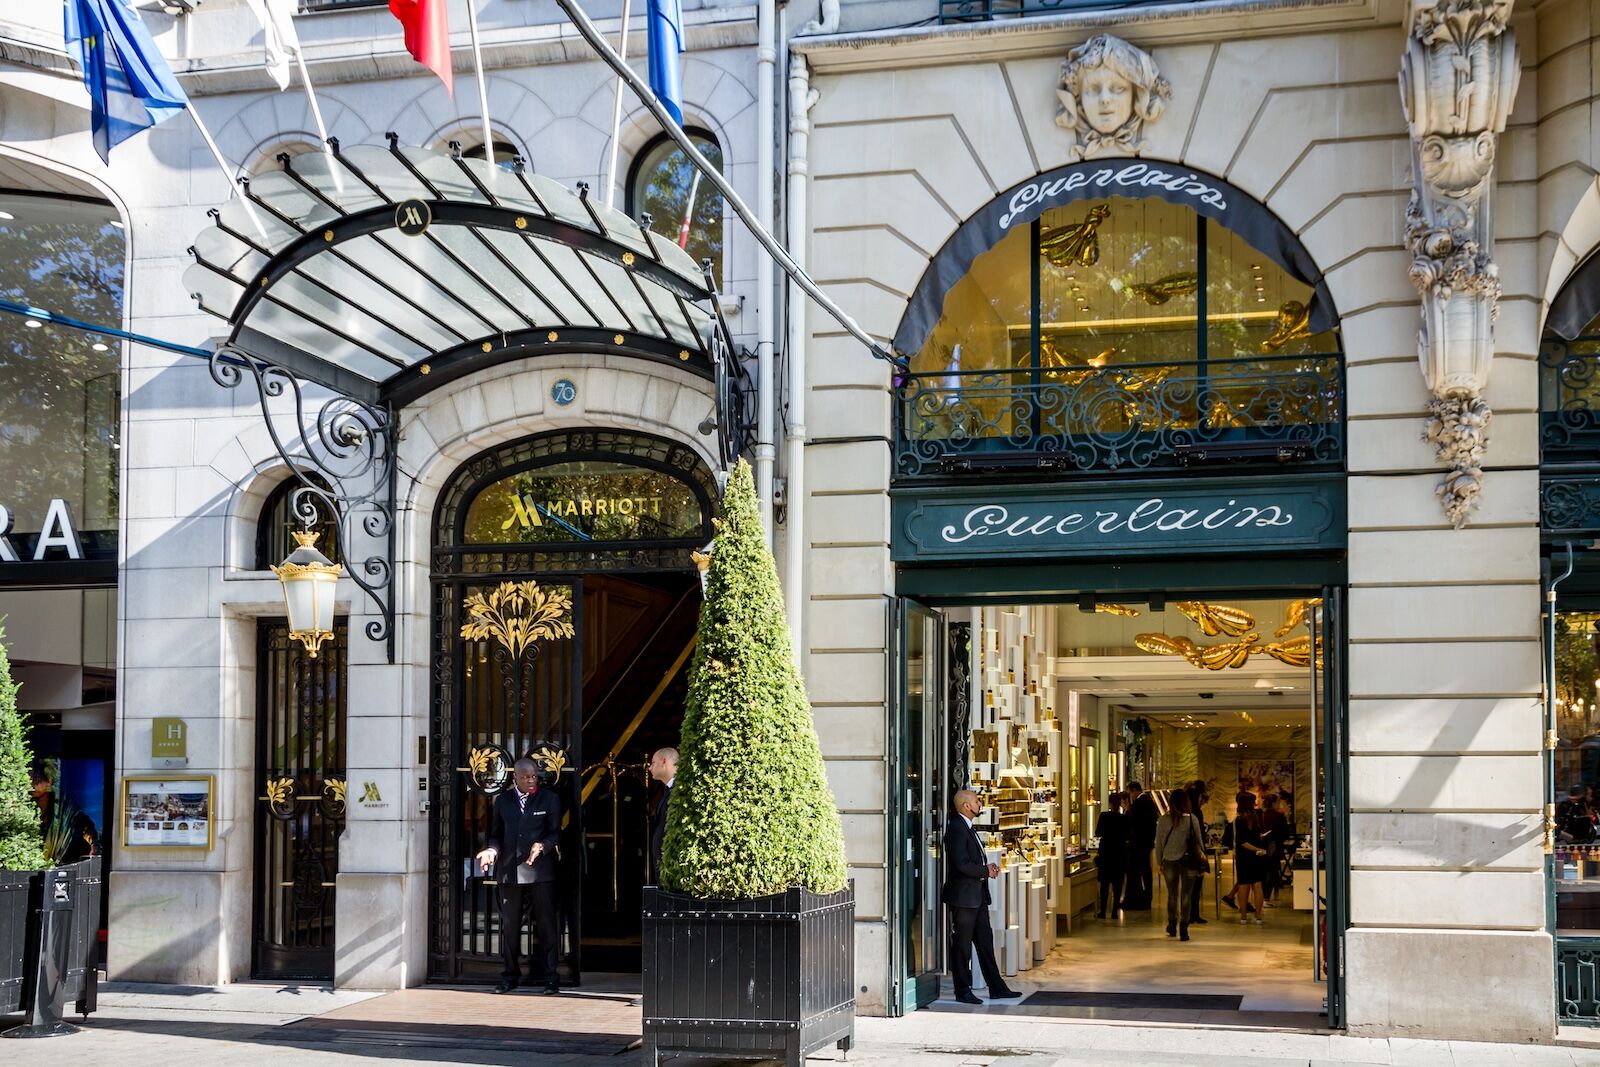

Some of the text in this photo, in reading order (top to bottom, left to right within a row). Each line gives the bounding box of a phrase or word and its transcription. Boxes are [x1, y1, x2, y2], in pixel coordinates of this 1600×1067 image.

[999, 163, 1227, 229] Guerlain
[555, 382, 576, 402] 70
[547, 497, 663, 517] MARRIOTT
[941, 498, 1292, 543] Guerlain
[167, 724, 181, 740] H
